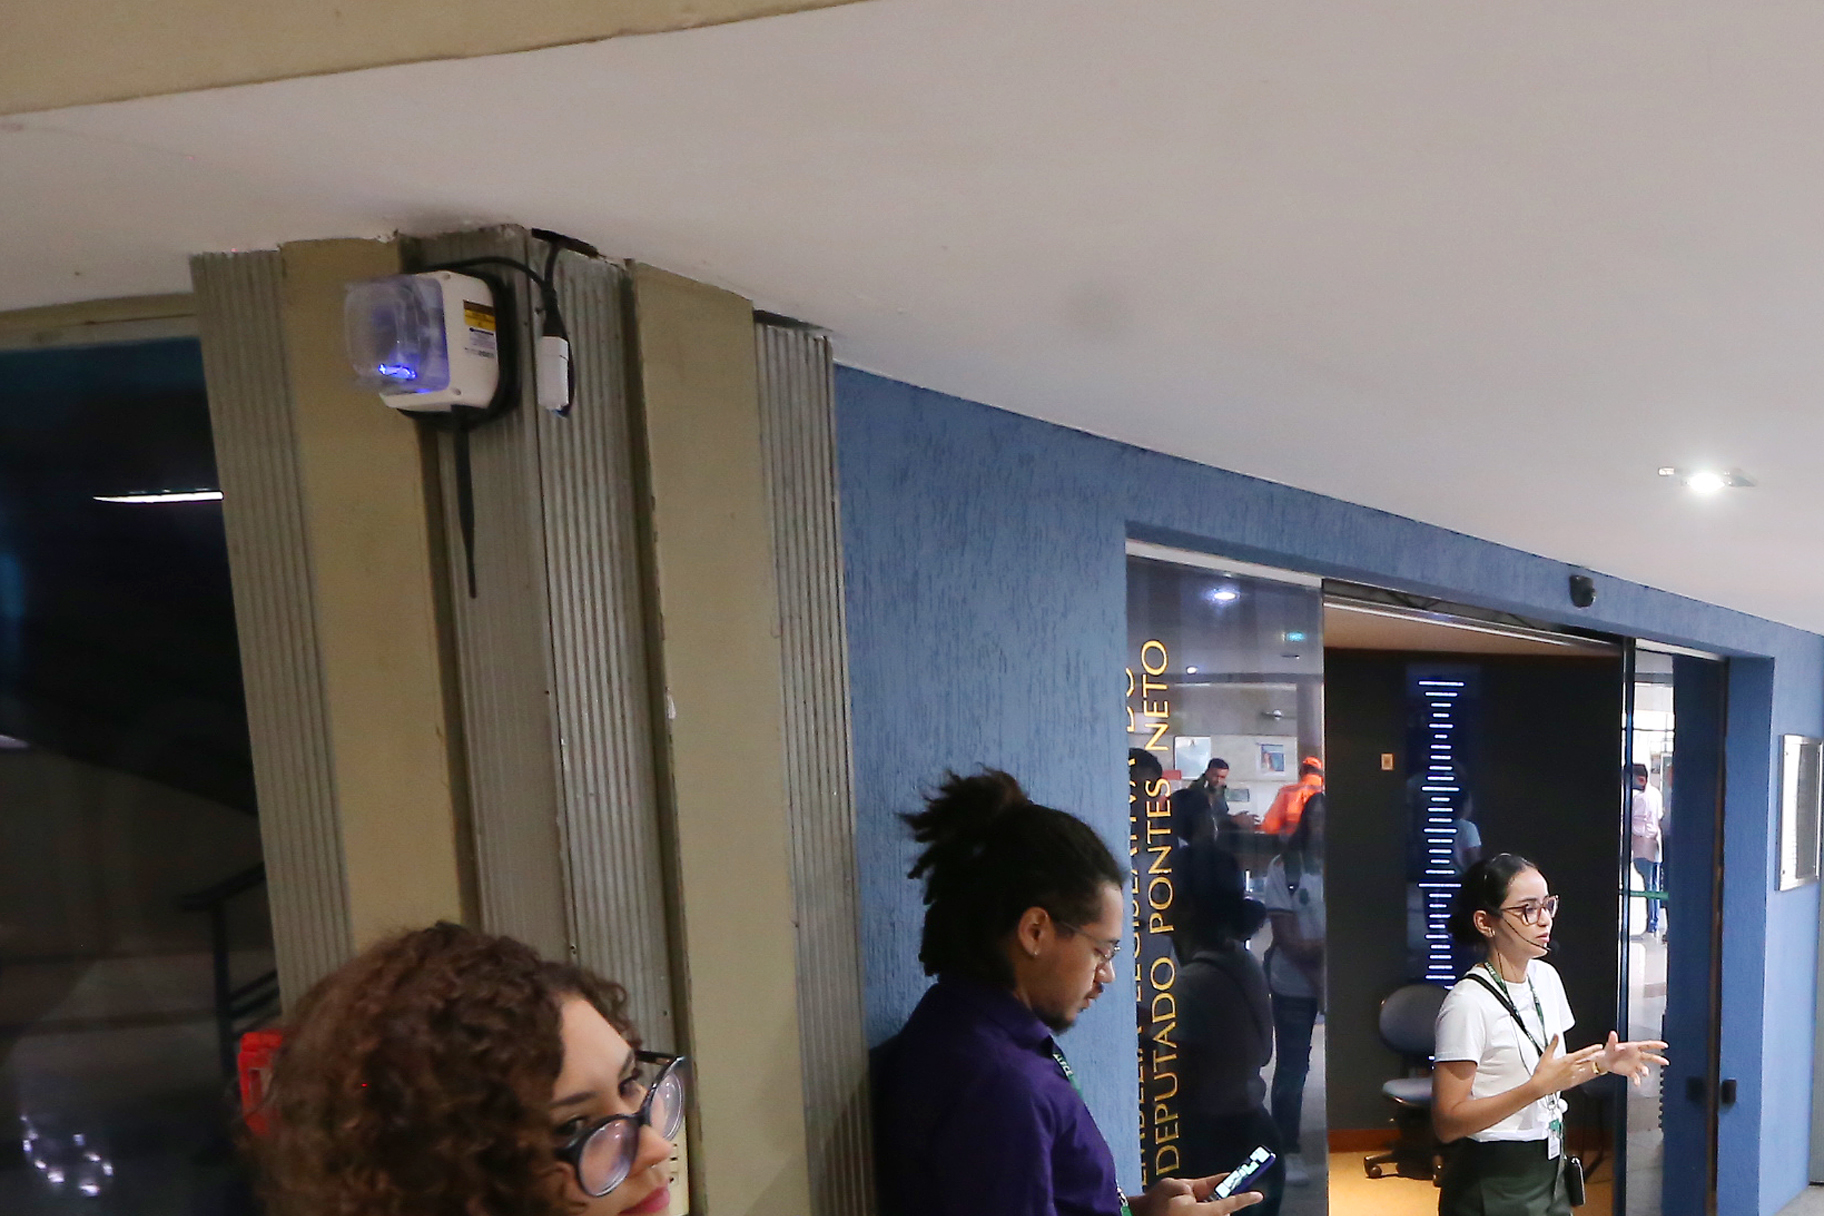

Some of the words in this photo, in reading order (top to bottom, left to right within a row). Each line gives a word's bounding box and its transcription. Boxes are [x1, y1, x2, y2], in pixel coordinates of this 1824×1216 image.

[1140, 639, 1170, 751] NETO
[1144, 778, 1175, 934] PONTES
[1150, 956, 1180, 1176] DEPUTADO
